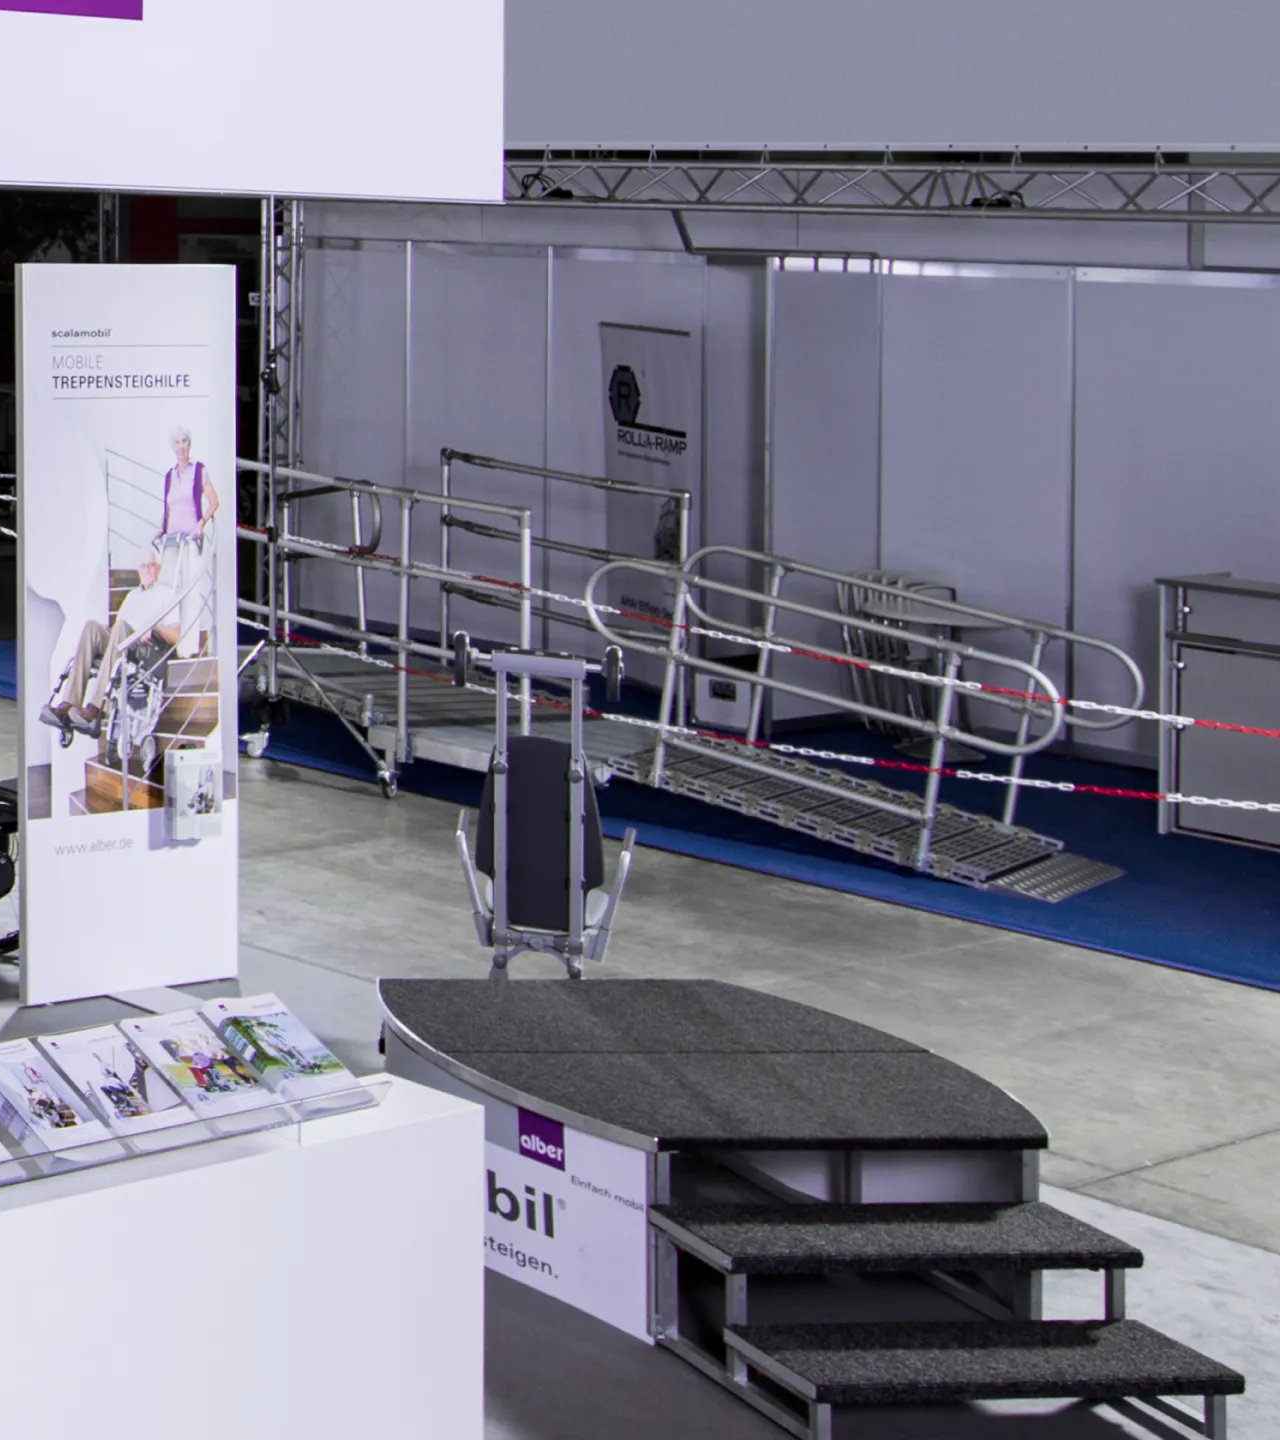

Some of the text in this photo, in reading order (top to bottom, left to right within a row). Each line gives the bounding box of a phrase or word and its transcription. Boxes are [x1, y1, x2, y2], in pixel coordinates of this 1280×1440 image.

[51, 328, 111, 338] scalamobil
[52, 355, 103, 370] MOBILE
[52, 374, 191, 389] TREPPENSTEIGHILFE
[54, 837, 134, 856] www.alber.de
[520, 1134, 564, 1162] alber
[570, 1175, 645, 1213] Einfach mobil
